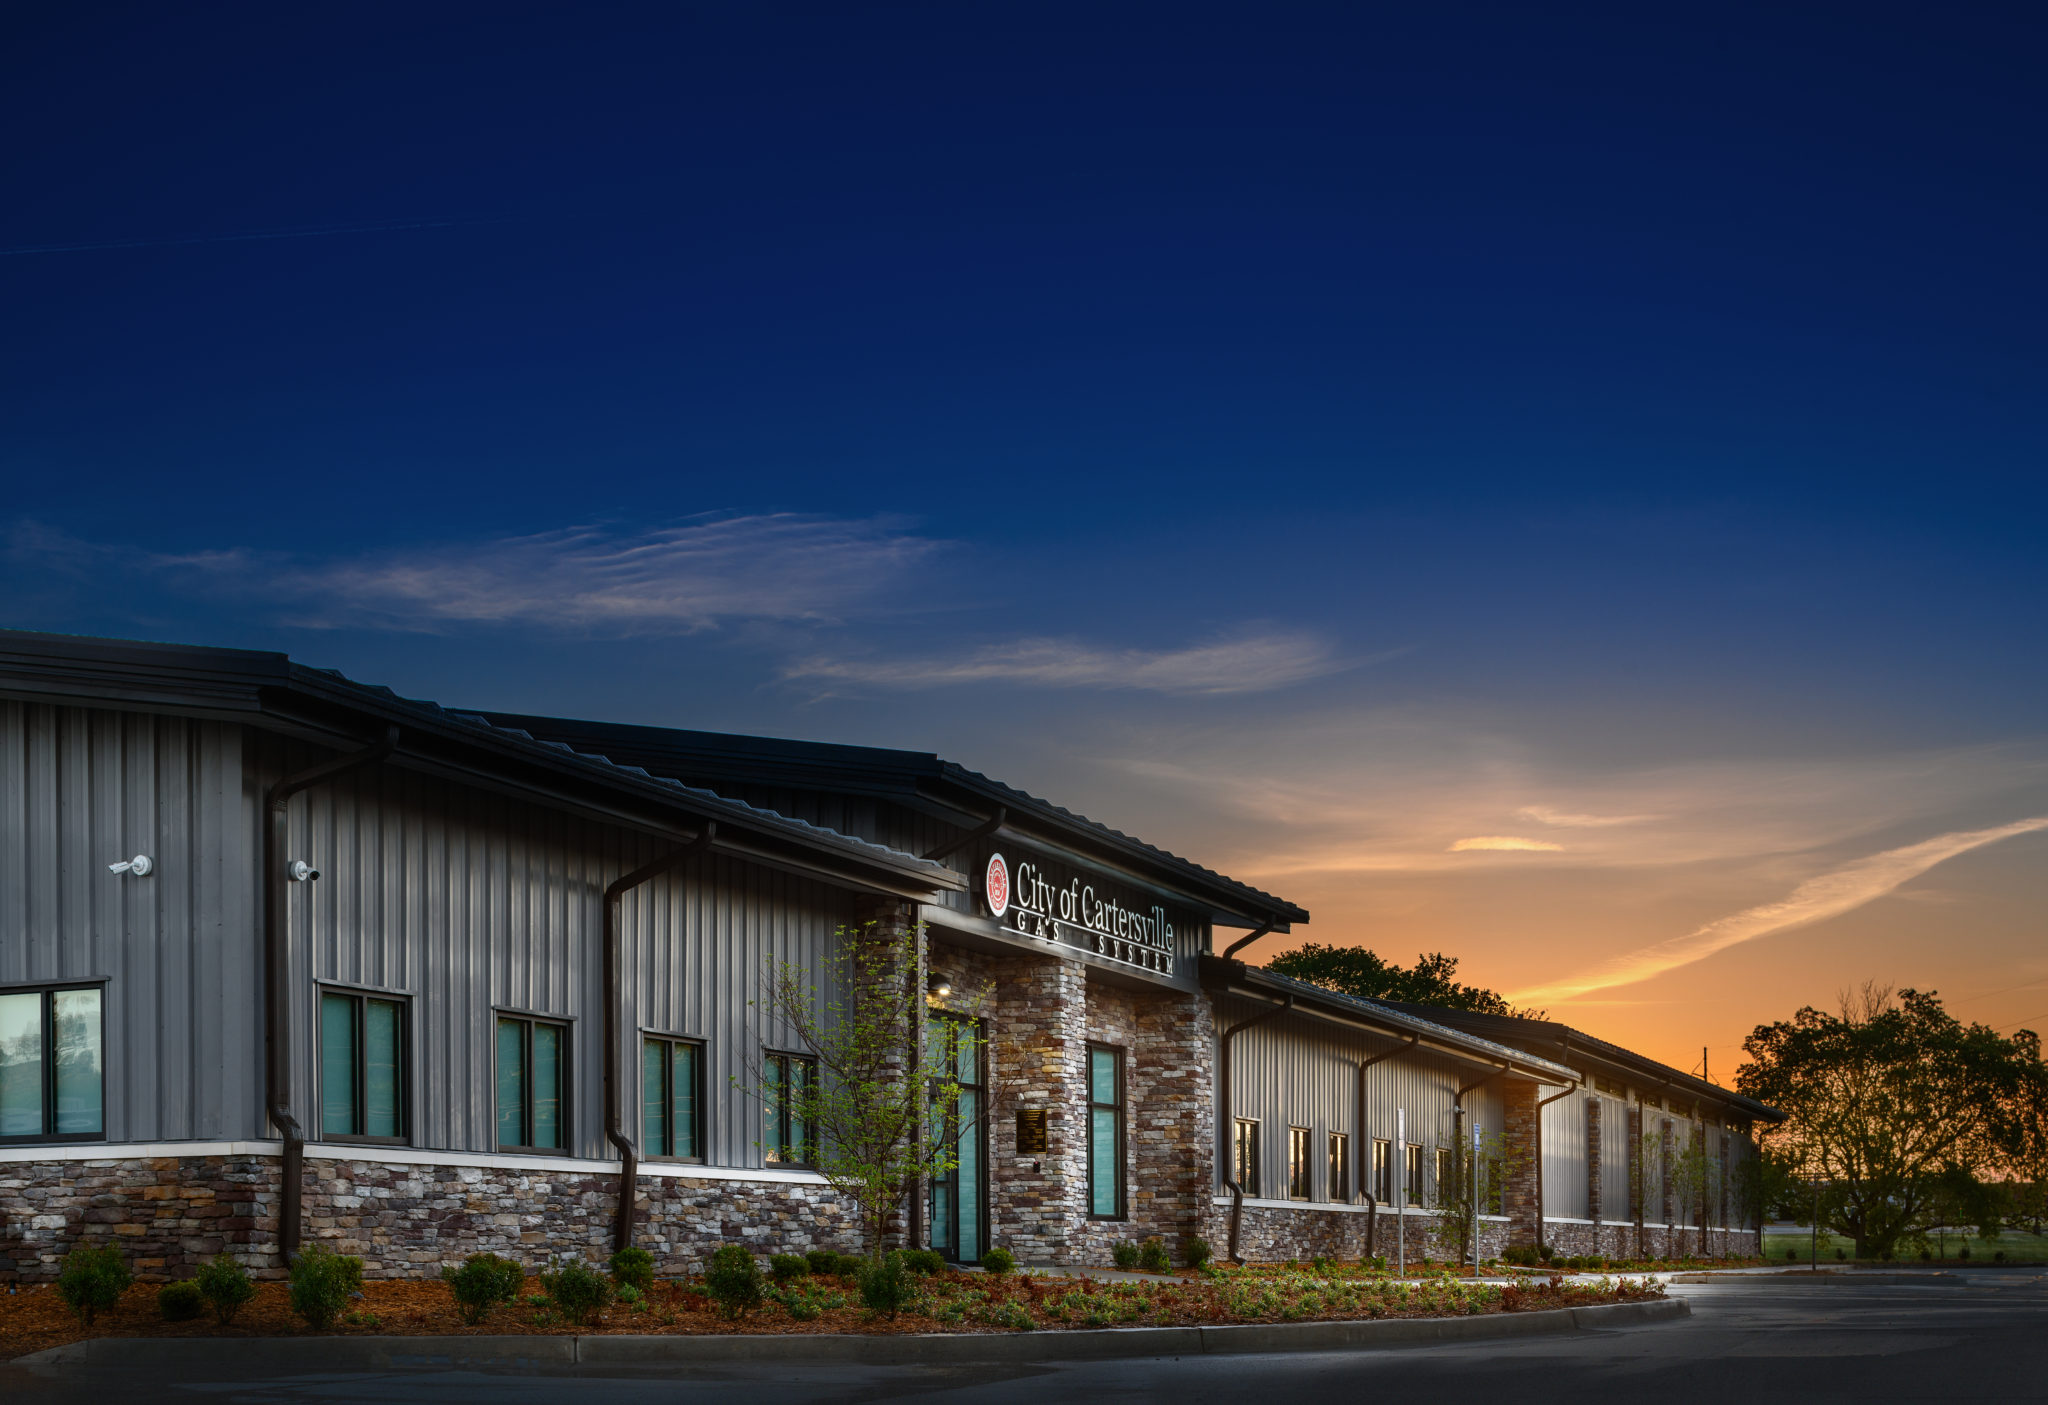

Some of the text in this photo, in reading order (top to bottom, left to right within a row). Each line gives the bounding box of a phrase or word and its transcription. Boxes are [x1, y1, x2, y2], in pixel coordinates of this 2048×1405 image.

[1017, 862, 1056, 926] City
[1060, 877, 1079, 922] of
[1082, 885, 1173, 951] Cartersville
[1017, 911, 1173, 974] GAS SYSTEM
